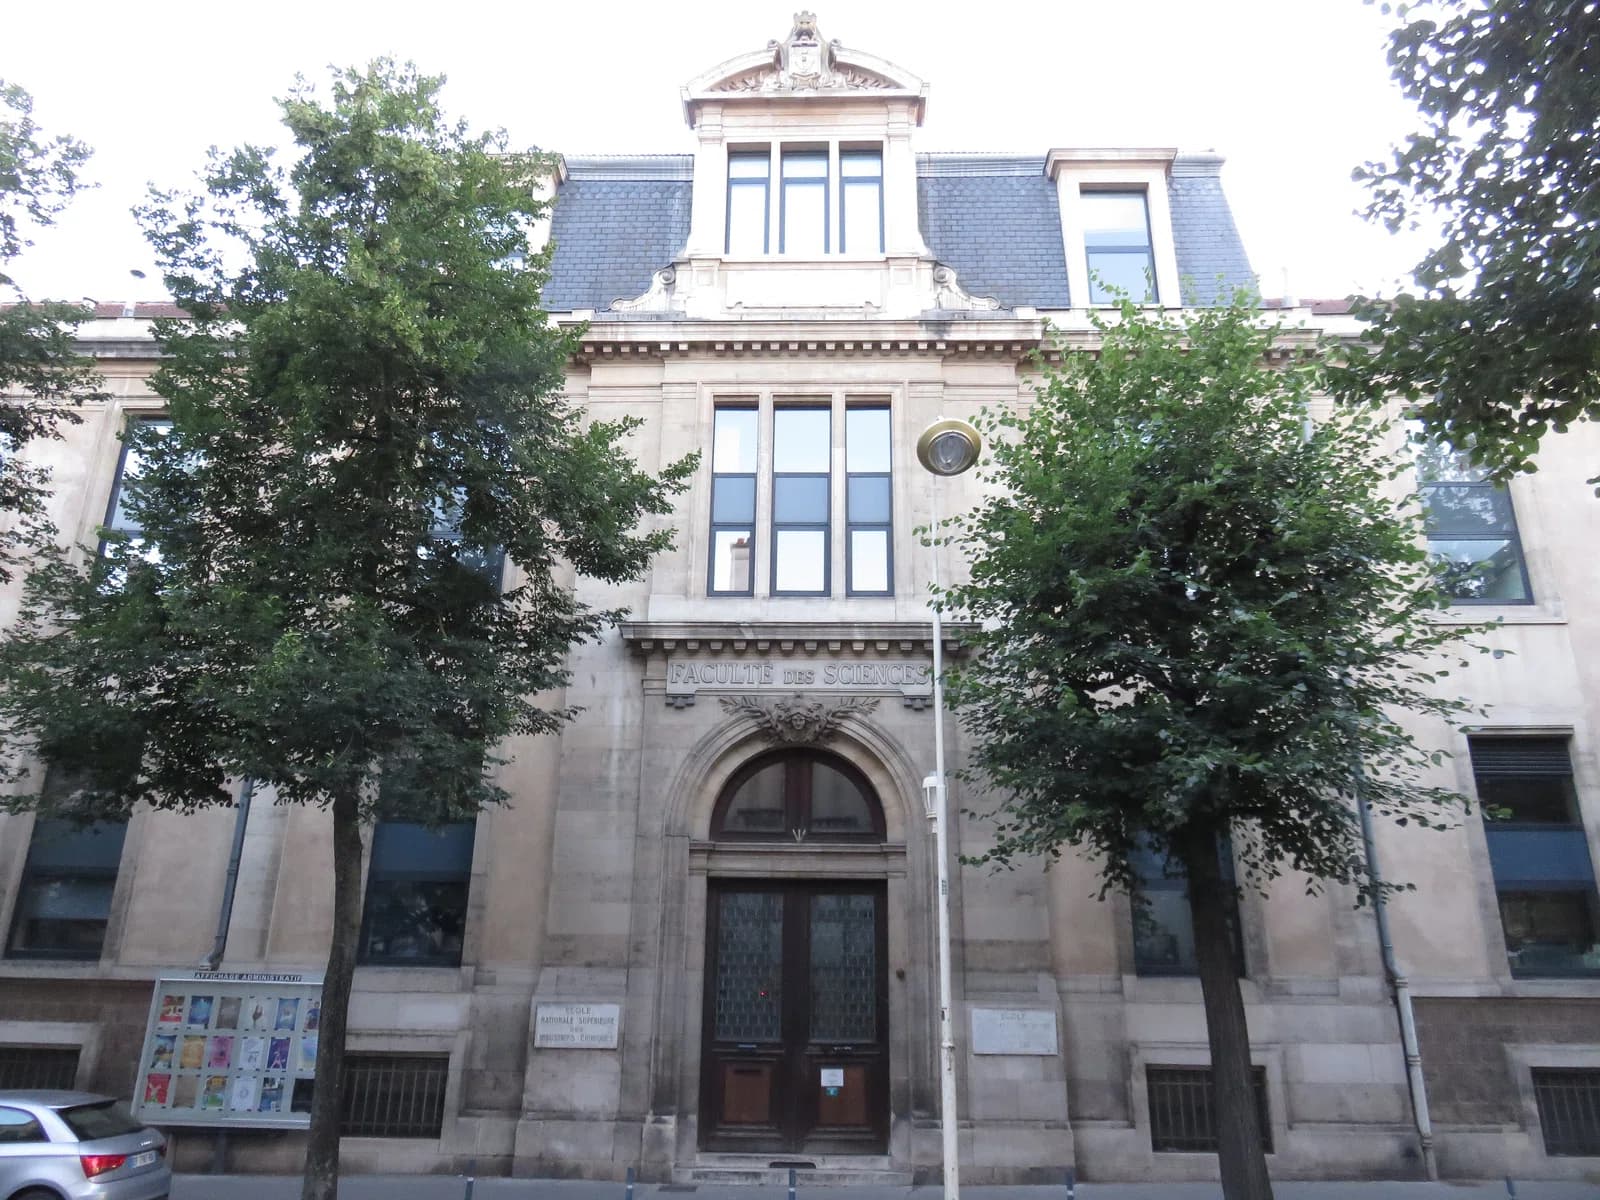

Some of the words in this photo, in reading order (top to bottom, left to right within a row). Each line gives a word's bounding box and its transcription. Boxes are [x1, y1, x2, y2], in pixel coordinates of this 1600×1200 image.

[783, 671, 815, 685] DES
[823, 663, 930, 685] SCIENCES
[241, 973, 301, 982] ADMINISTRATIF
[540, 1016, 573, 1025] NATIONALE
